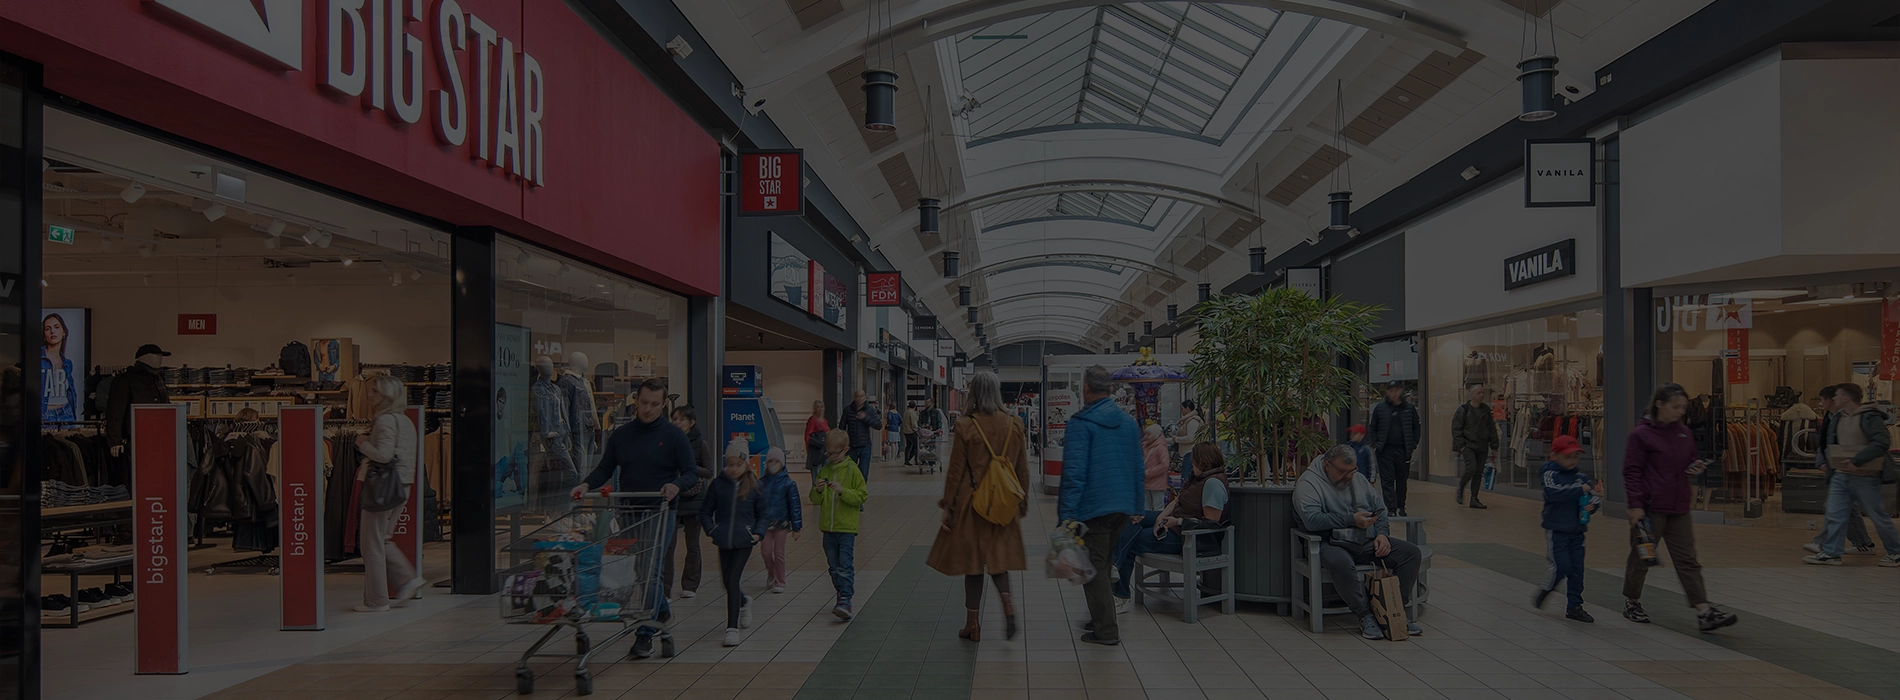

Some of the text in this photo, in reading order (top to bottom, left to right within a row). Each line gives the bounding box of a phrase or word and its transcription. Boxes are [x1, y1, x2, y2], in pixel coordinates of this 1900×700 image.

[327, 0, 545, 188] BIG STAR
[759, 156, 781, 179] BIG
[1537, 169, 1584, 177] VANILA
[759, 180, 781, 195] STAR
[1509, 249, 1563, 283] VANILA
[871, 291, 897, 300] FDM
[188, 319, 206, 330] MEN
[731, 413, 755, 421] Planet
[290, 483, 309, 556] bigstar.pl
[146, 496, 168, 584] bigstar.pl
